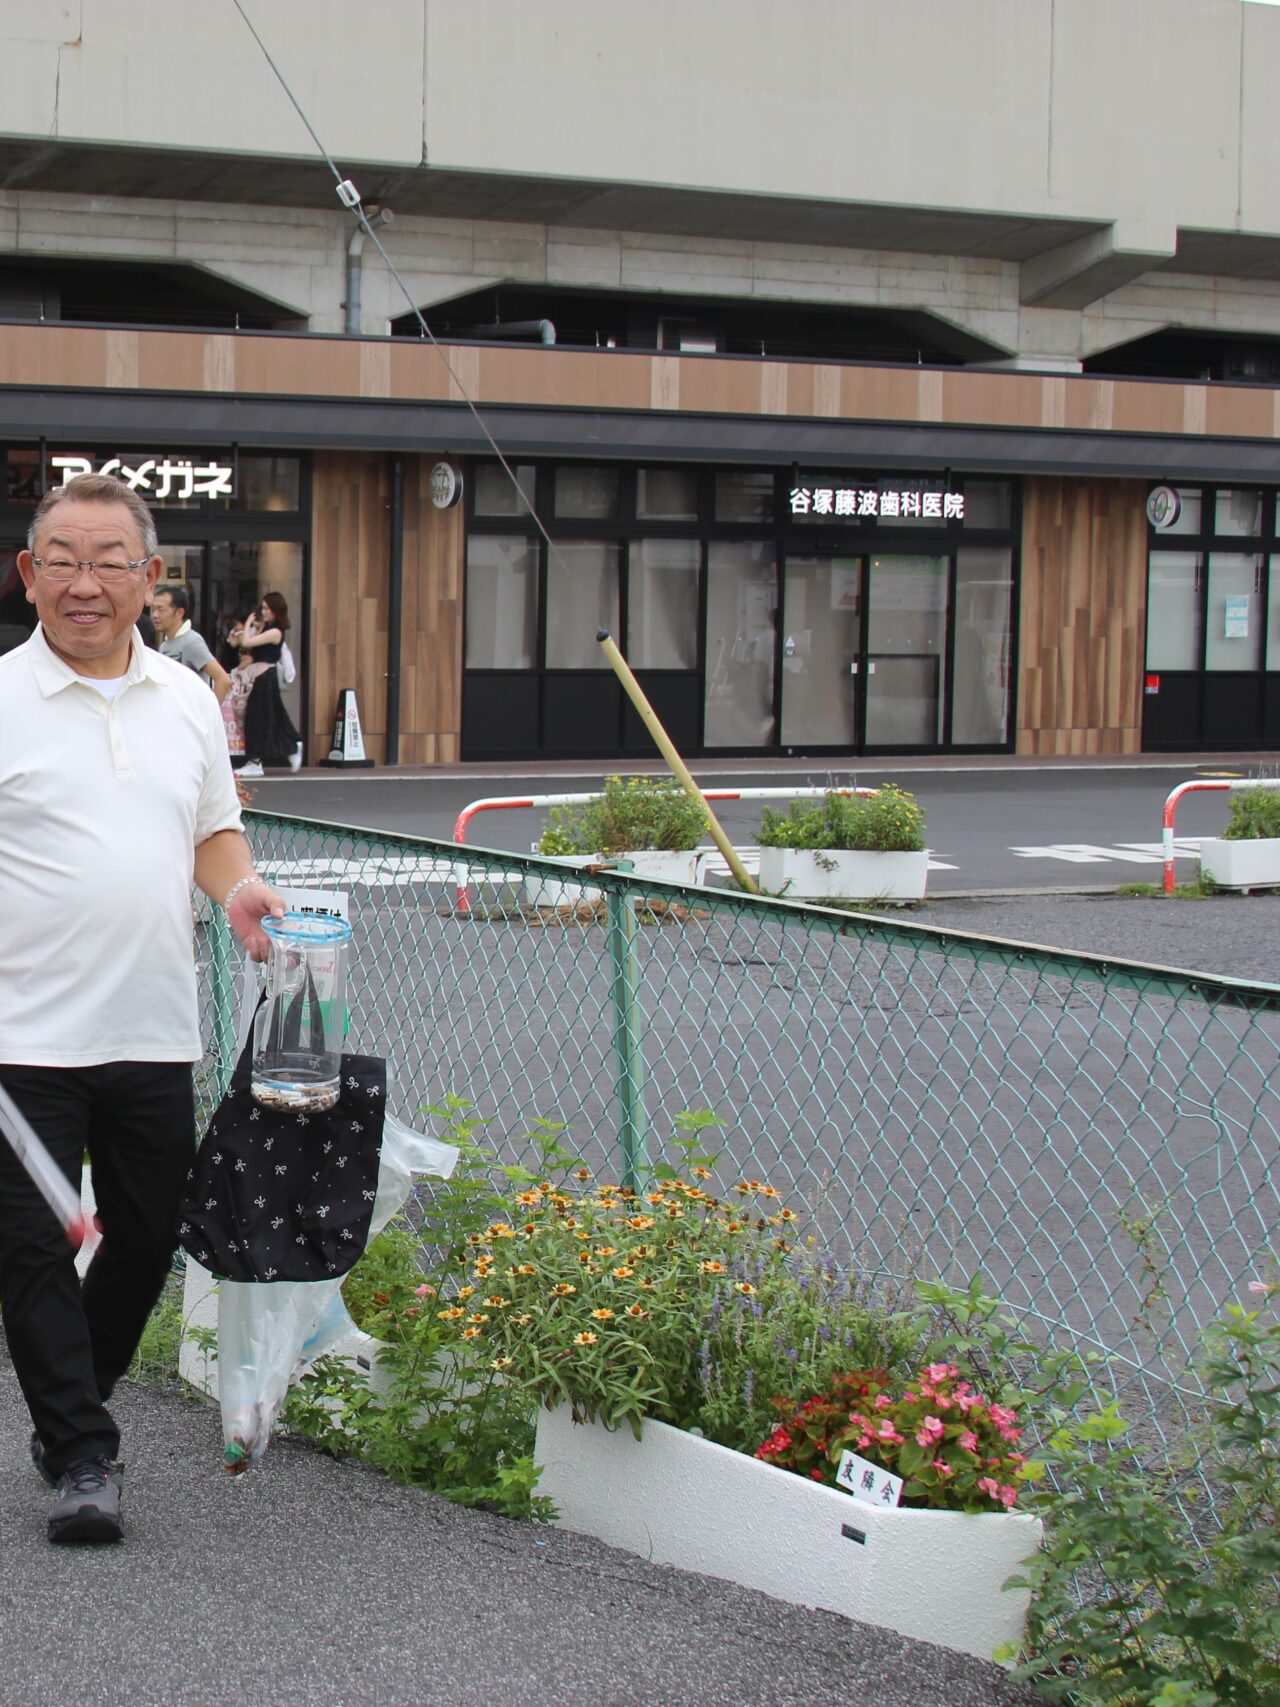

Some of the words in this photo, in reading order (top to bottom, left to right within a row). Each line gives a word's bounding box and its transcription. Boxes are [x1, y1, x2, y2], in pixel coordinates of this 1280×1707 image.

[789, 487, 965, 519] 谷塚藤波歯科医院
